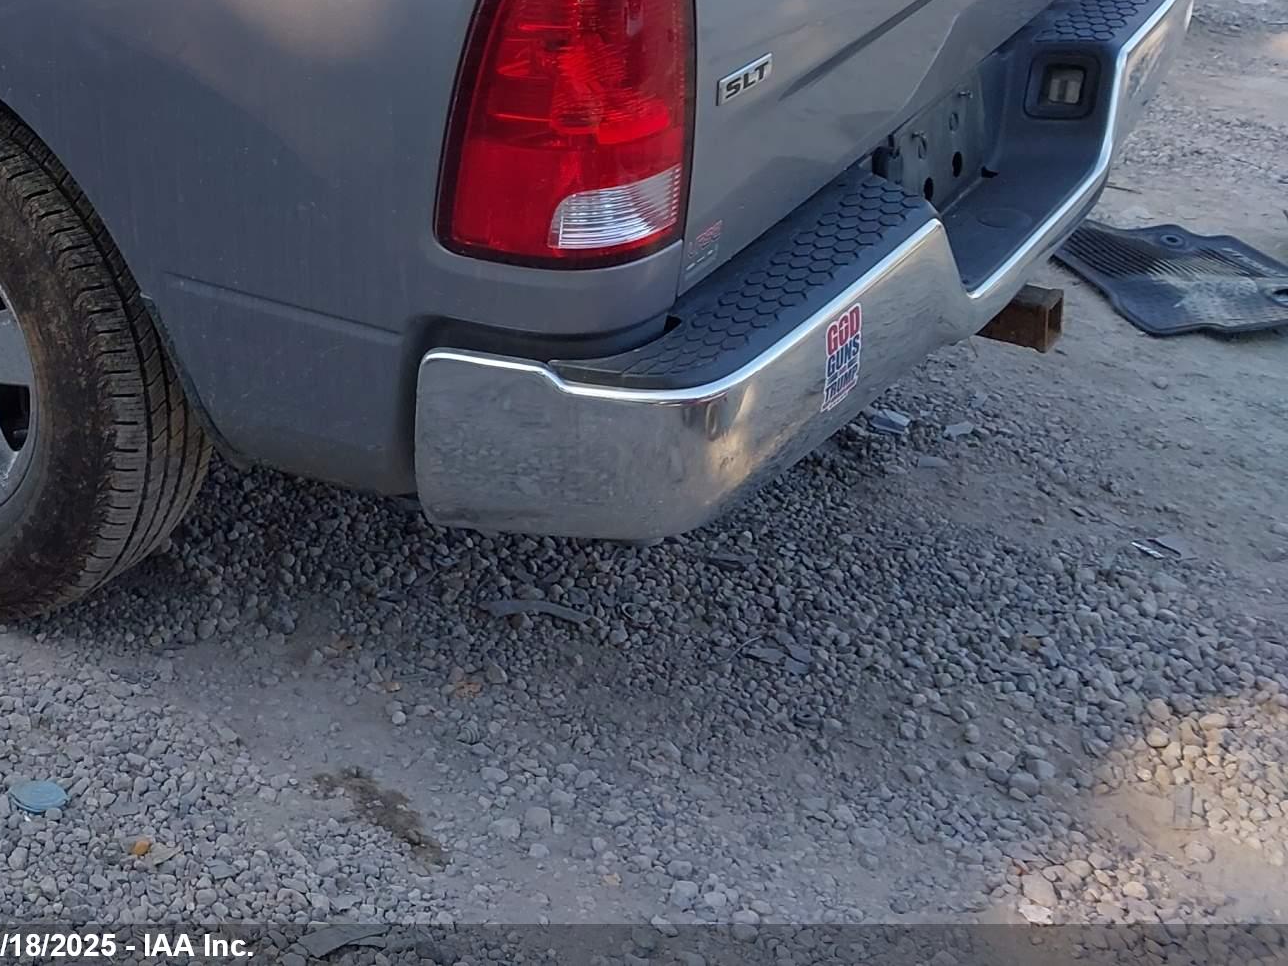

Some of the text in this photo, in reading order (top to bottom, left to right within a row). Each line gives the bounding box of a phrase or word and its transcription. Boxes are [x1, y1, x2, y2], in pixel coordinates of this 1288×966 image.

[725, 61, 769, 99] SLT
[827, 305, 861, 356] GOD
[827, 334, 860, 378] GUNS
[825, 363, 858, 403] TRUMP
